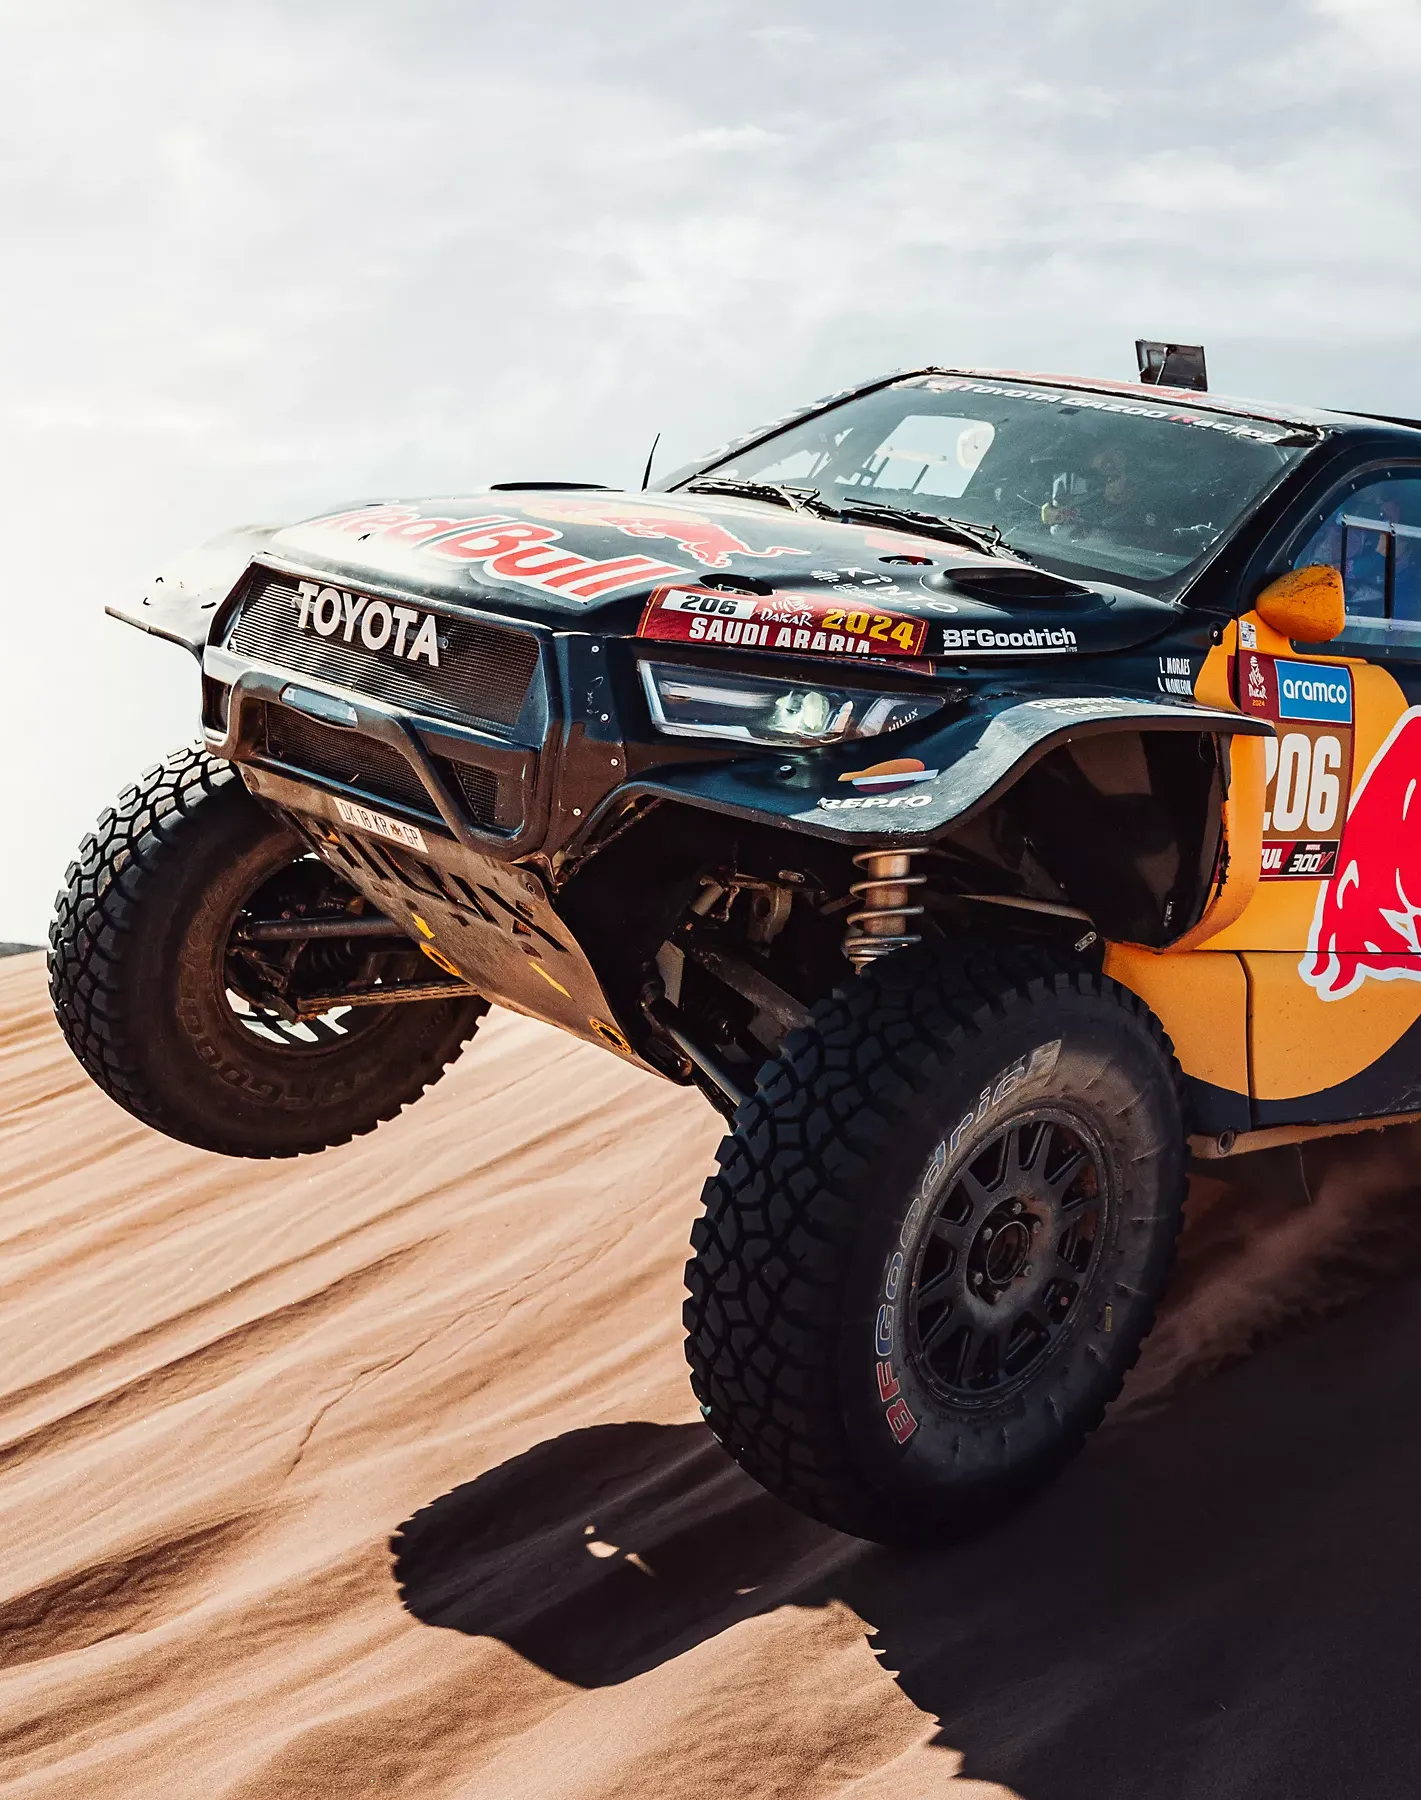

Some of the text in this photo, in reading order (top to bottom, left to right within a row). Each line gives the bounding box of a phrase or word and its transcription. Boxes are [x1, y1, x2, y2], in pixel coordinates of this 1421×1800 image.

[957, 383, 1062, 403] TOYOTA
[1061, 397, 1168, 419] GAZOO
[426, 521, 692, 602] Bull
[680, 595, 738, 615] 206
[760, 607, 813, 627] DAKAR
[298, 581, 439, 667] TOYOTA
[689, 617, 870, 654] SAUDI ARABIA
[821, 608, 914, 650] 2024
[943, 628, 1077, 647] BFGoodrich
[1283, 679, 1347, 704] aramco
[889, 708, 919, 732] HILUX
[340, 802, 359, 824] DK
[372, 814, 391, 836] KR
[403, 826, 418, 847] GP
[1289, 851, 1335, 873] 300V
